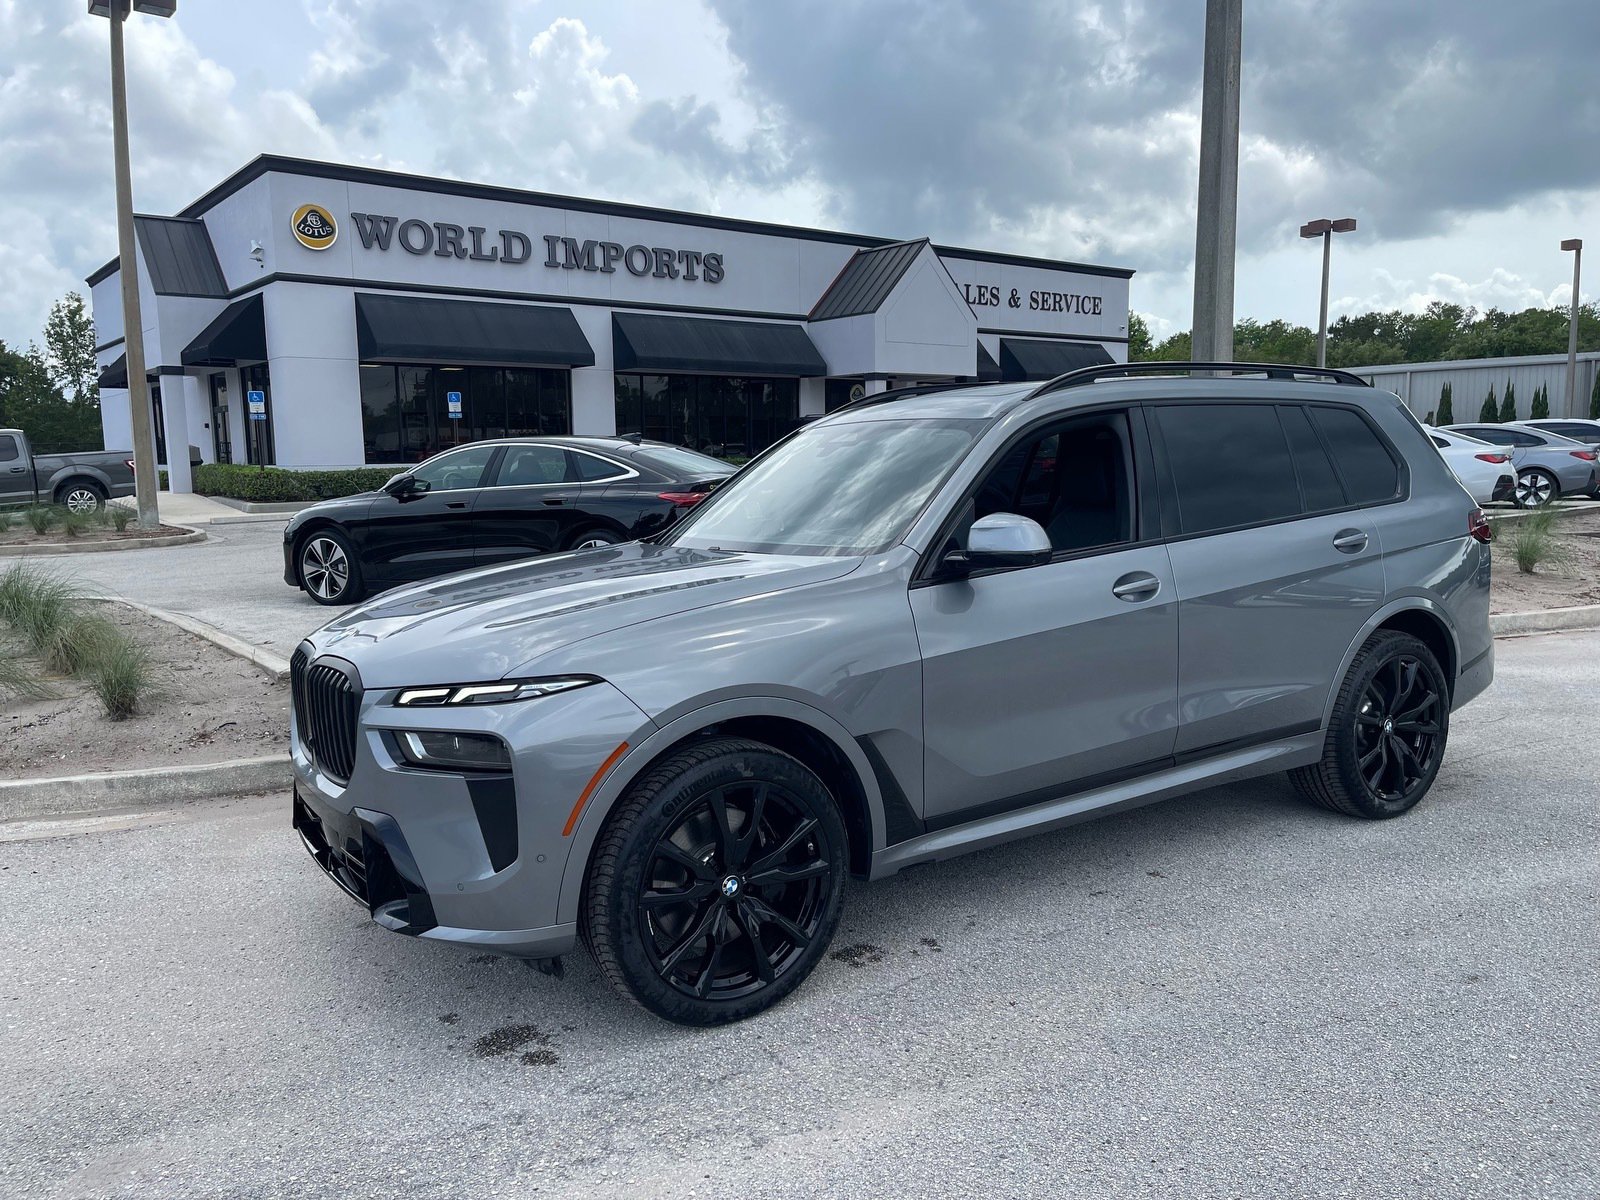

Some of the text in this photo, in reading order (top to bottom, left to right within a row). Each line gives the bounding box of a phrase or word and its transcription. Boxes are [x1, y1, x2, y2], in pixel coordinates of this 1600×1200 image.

[298, 223, 333, 236] LOTUS
[350, 212, 725, 283] WORLD IMPORTS
[955, 283, 1102, 316] LES & SERVICE
